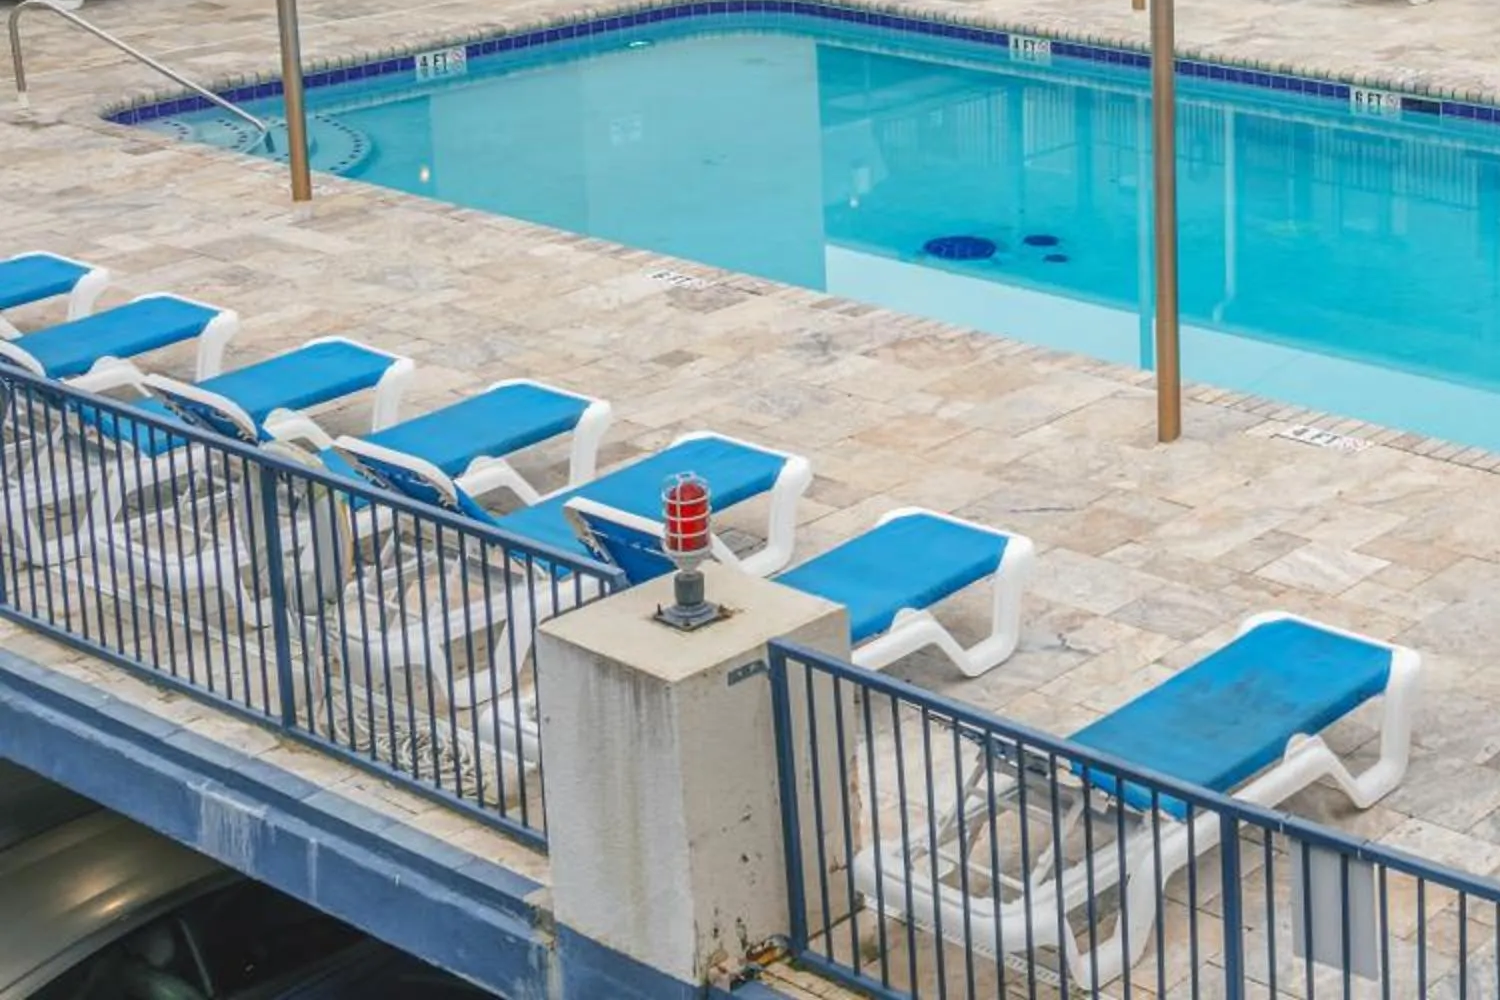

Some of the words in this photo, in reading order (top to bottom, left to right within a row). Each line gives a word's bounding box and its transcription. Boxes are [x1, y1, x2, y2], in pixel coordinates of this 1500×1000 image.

[1023, 39, 1036, 51] FT
[419, 55, 429, 67] 4
[433, 53, 448, 68] FT
[1367, 93, 1382, 106] FT
